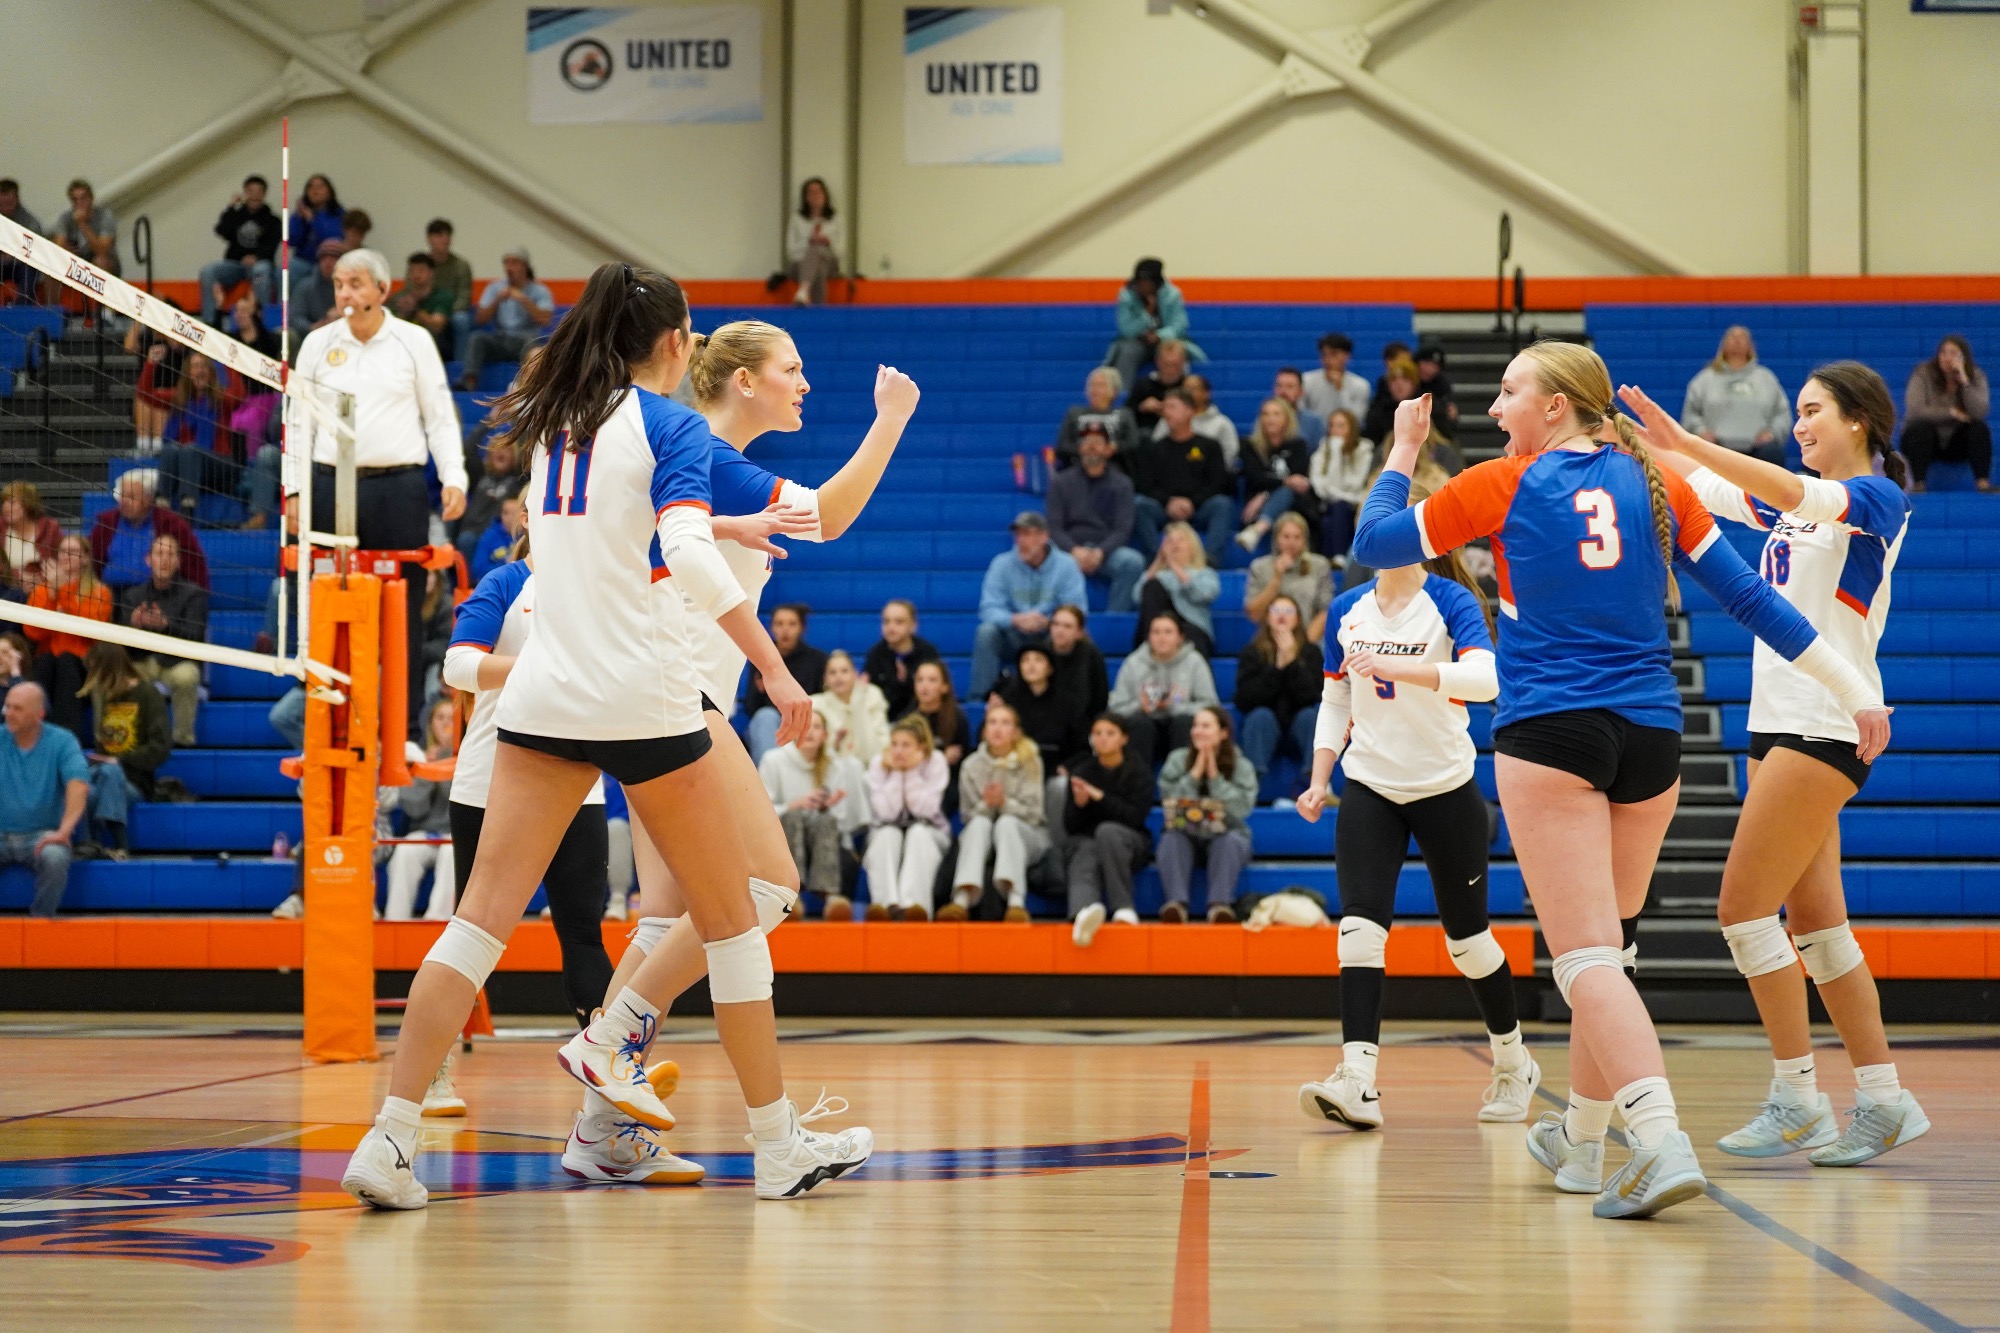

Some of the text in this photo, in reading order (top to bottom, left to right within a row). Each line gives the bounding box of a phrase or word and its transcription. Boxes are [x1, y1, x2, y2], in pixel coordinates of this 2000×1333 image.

[626, 38, 731, 70] UNITED
[926, 62, 1040, 95] UNITED
[542, 430, 597, 518] 11
[1573, 486, 1623, 571] 3
[1765, 537, 1792, 586] 18
